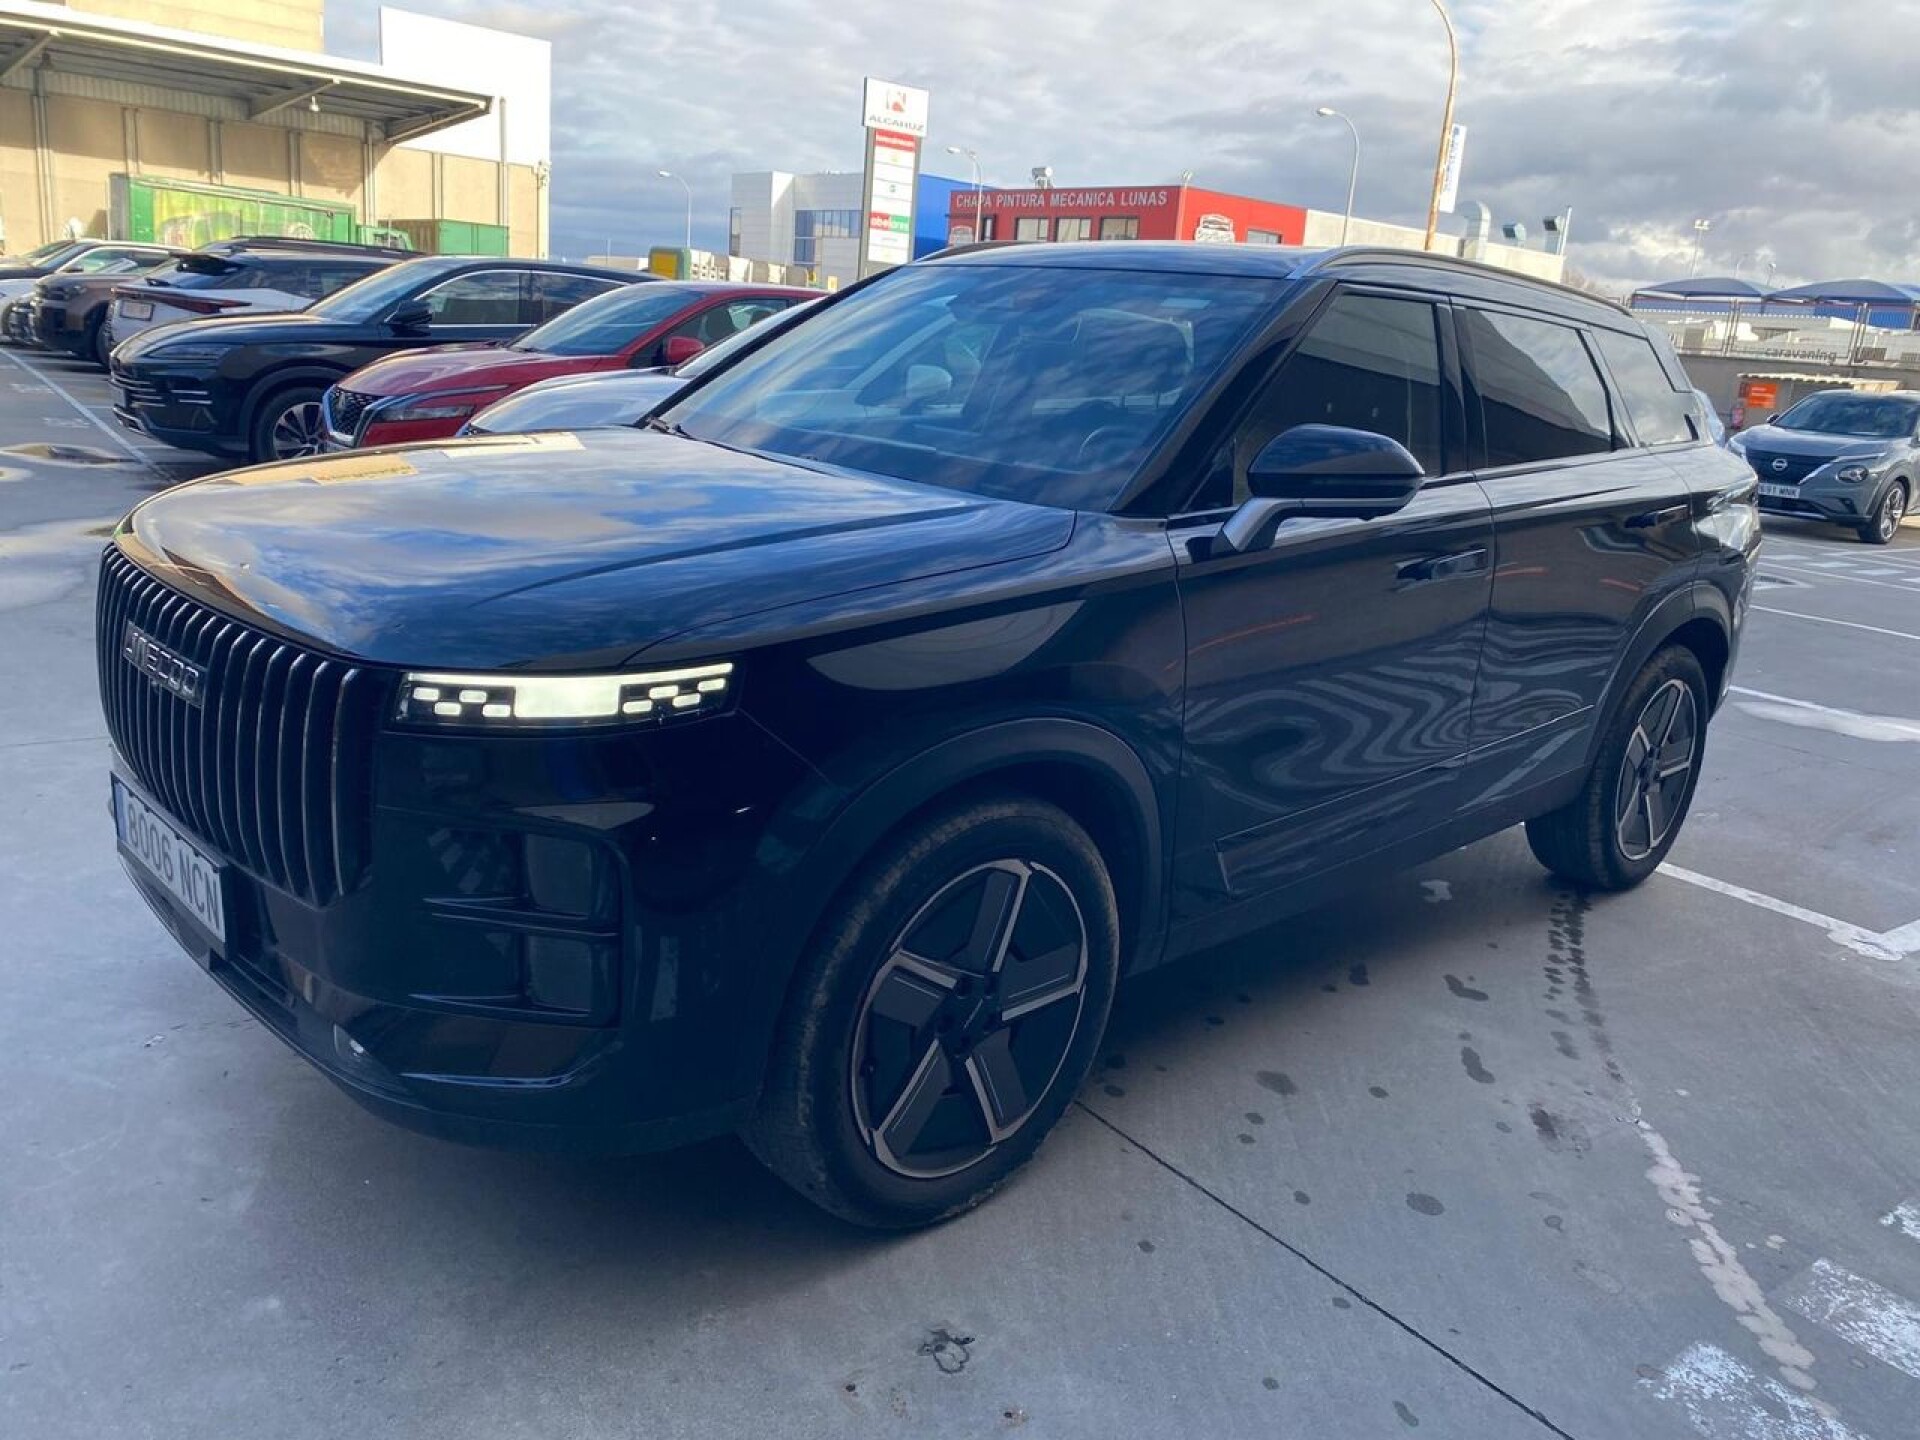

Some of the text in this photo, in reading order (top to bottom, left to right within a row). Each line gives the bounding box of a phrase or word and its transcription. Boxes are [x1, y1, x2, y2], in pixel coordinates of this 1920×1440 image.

[956, 191, 1168, 208] CHAPA PINTURA MECANICA LUNAS
[1766, 347, 1837, 366] caravaning
[128, 803, 220, 930] 8006 NCN
